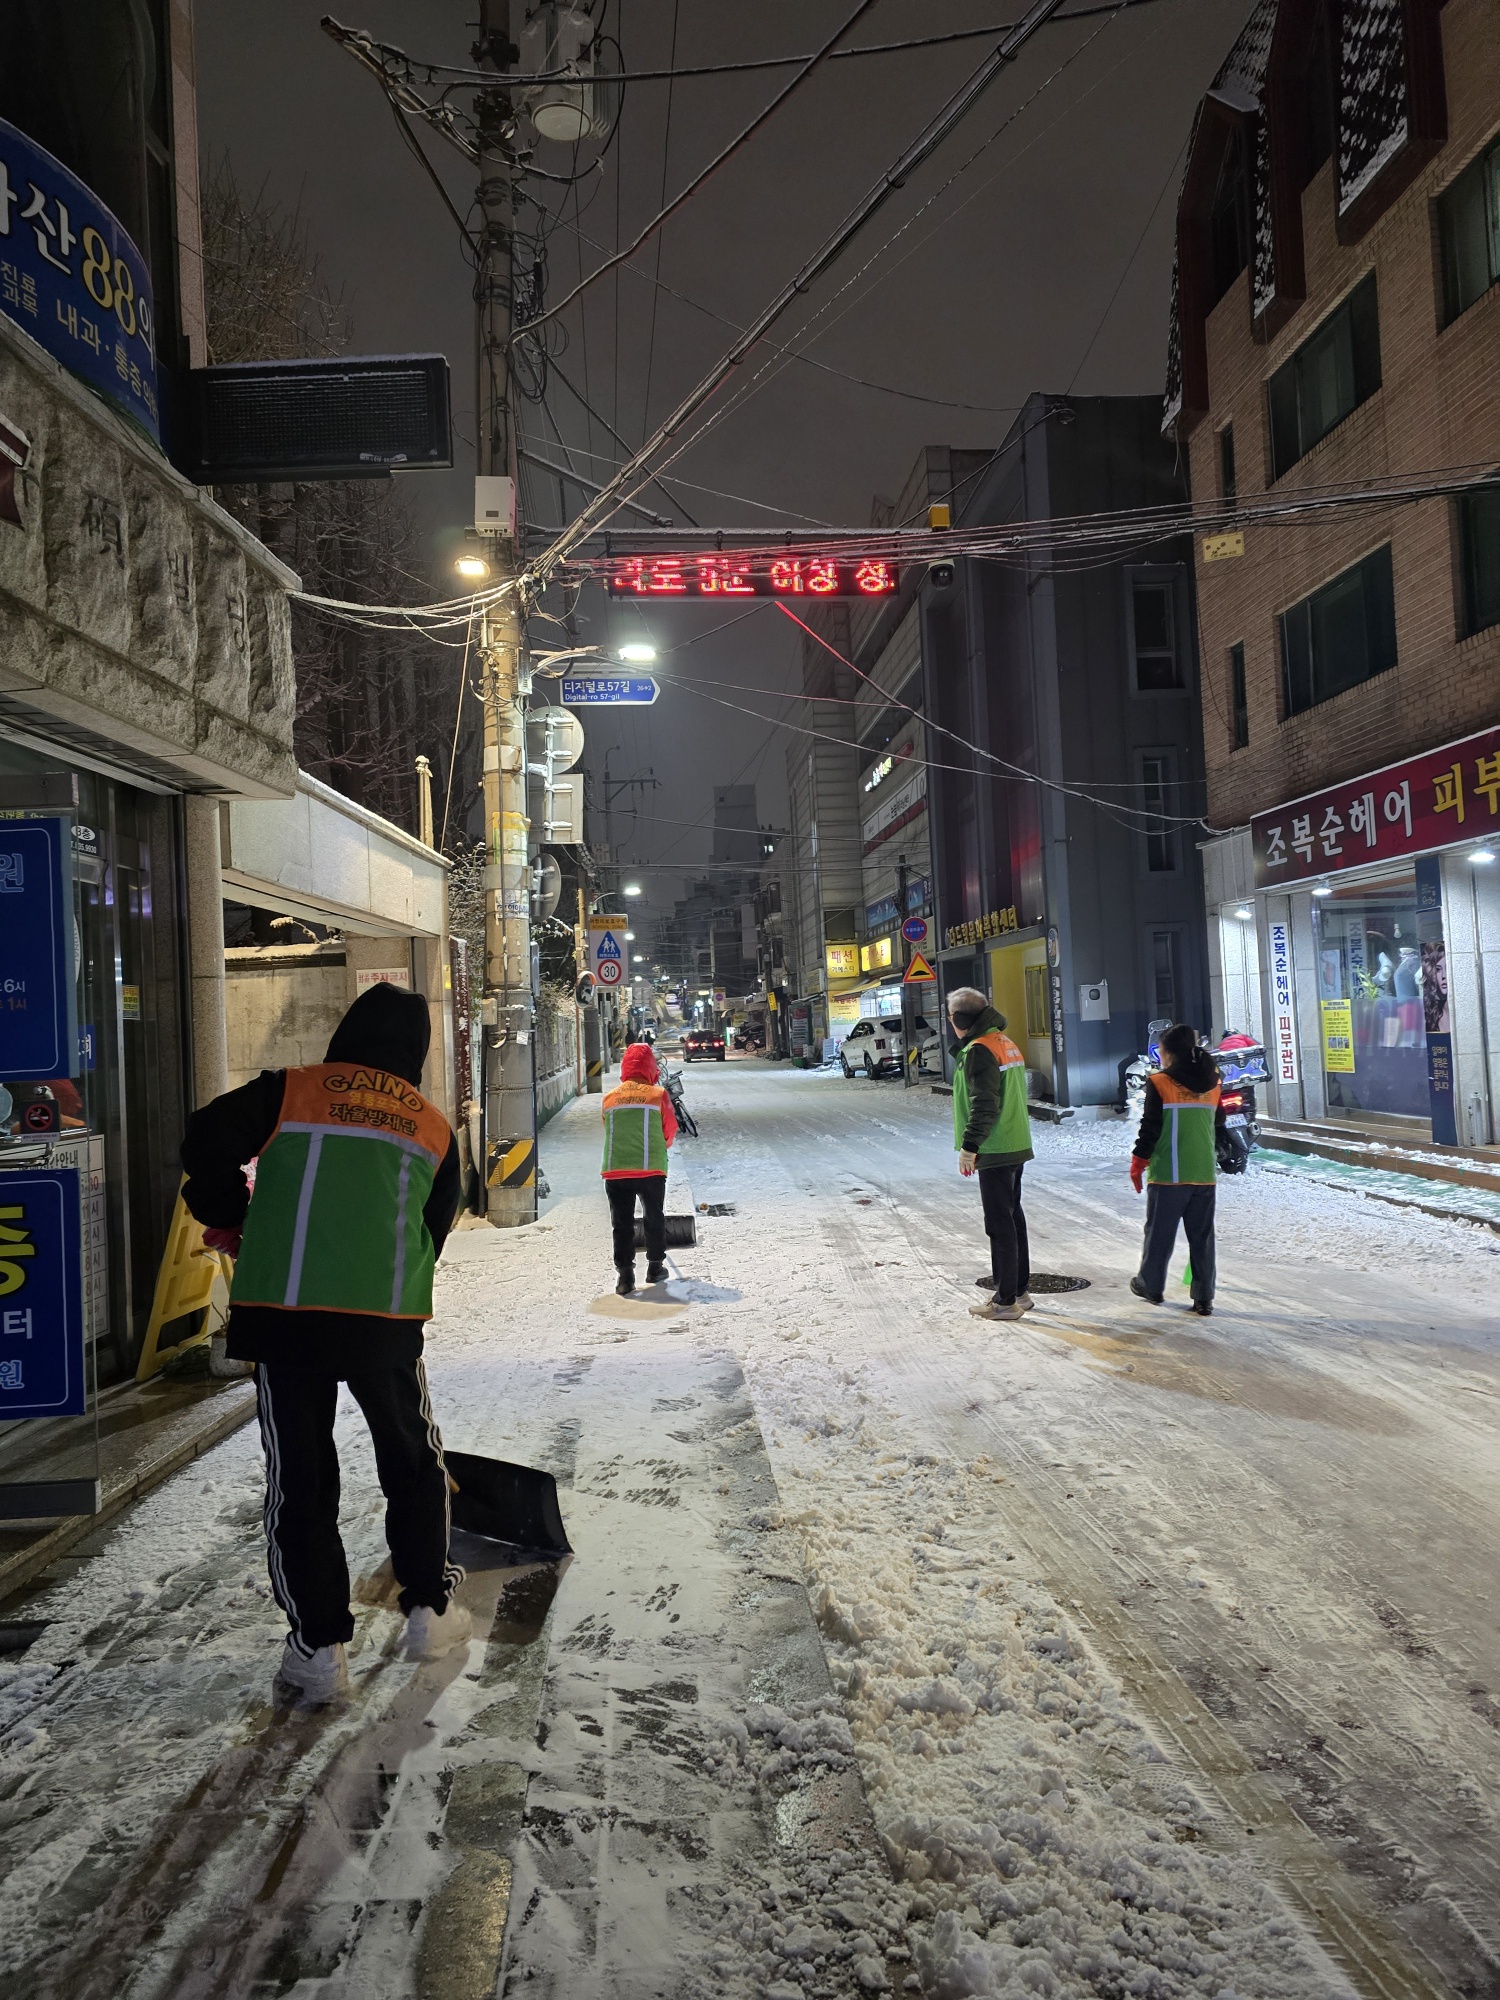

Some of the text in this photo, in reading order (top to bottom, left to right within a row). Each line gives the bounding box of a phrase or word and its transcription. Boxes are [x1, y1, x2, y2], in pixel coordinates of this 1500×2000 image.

[564, 680, 630, 693] 디지털로57길
[564, 693, 620, 701] Digital-ro 57-gil
[1265, 780, 1413, 867] 조복순헤어
[831, 949, 854, 963] 패션
[371, 971, 408, 983] 주차금지
[603, 965, 616, 978] 30
[3, 978, 26, 993] 6시
[349, 1091, 401, 1112] 영등포구
[329, 1103, 418, 1137] 자율방재단
[3, 1308, 33, 1339] 터
